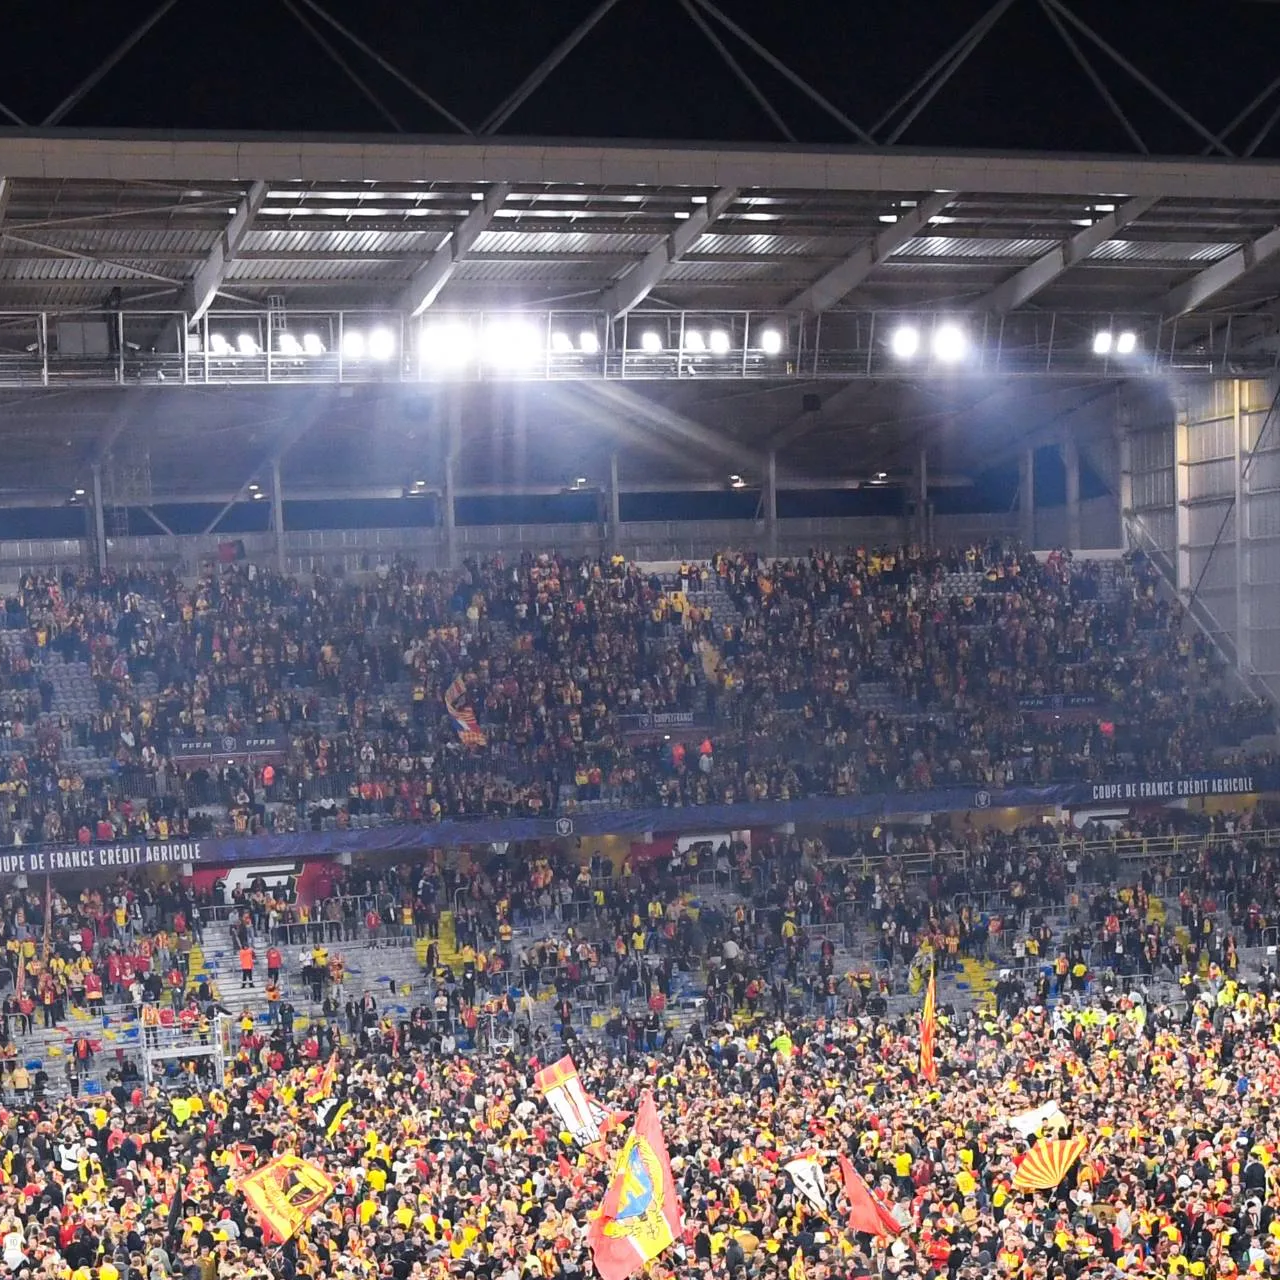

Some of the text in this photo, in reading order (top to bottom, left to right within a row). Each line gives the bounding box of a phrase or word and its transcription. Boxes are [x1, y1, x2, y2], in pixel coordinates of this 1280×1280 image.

[1093, 777, 1253, 799] COUPE DE FRANCE CRÉDIT AGRICOLE
[30, 853, 44, 870] DE
[50, 850, 94, 868] FRANCE
[99, 845, 141, 865] CRÉDIT
[146, 843, 201, 863] AGRICOLE
